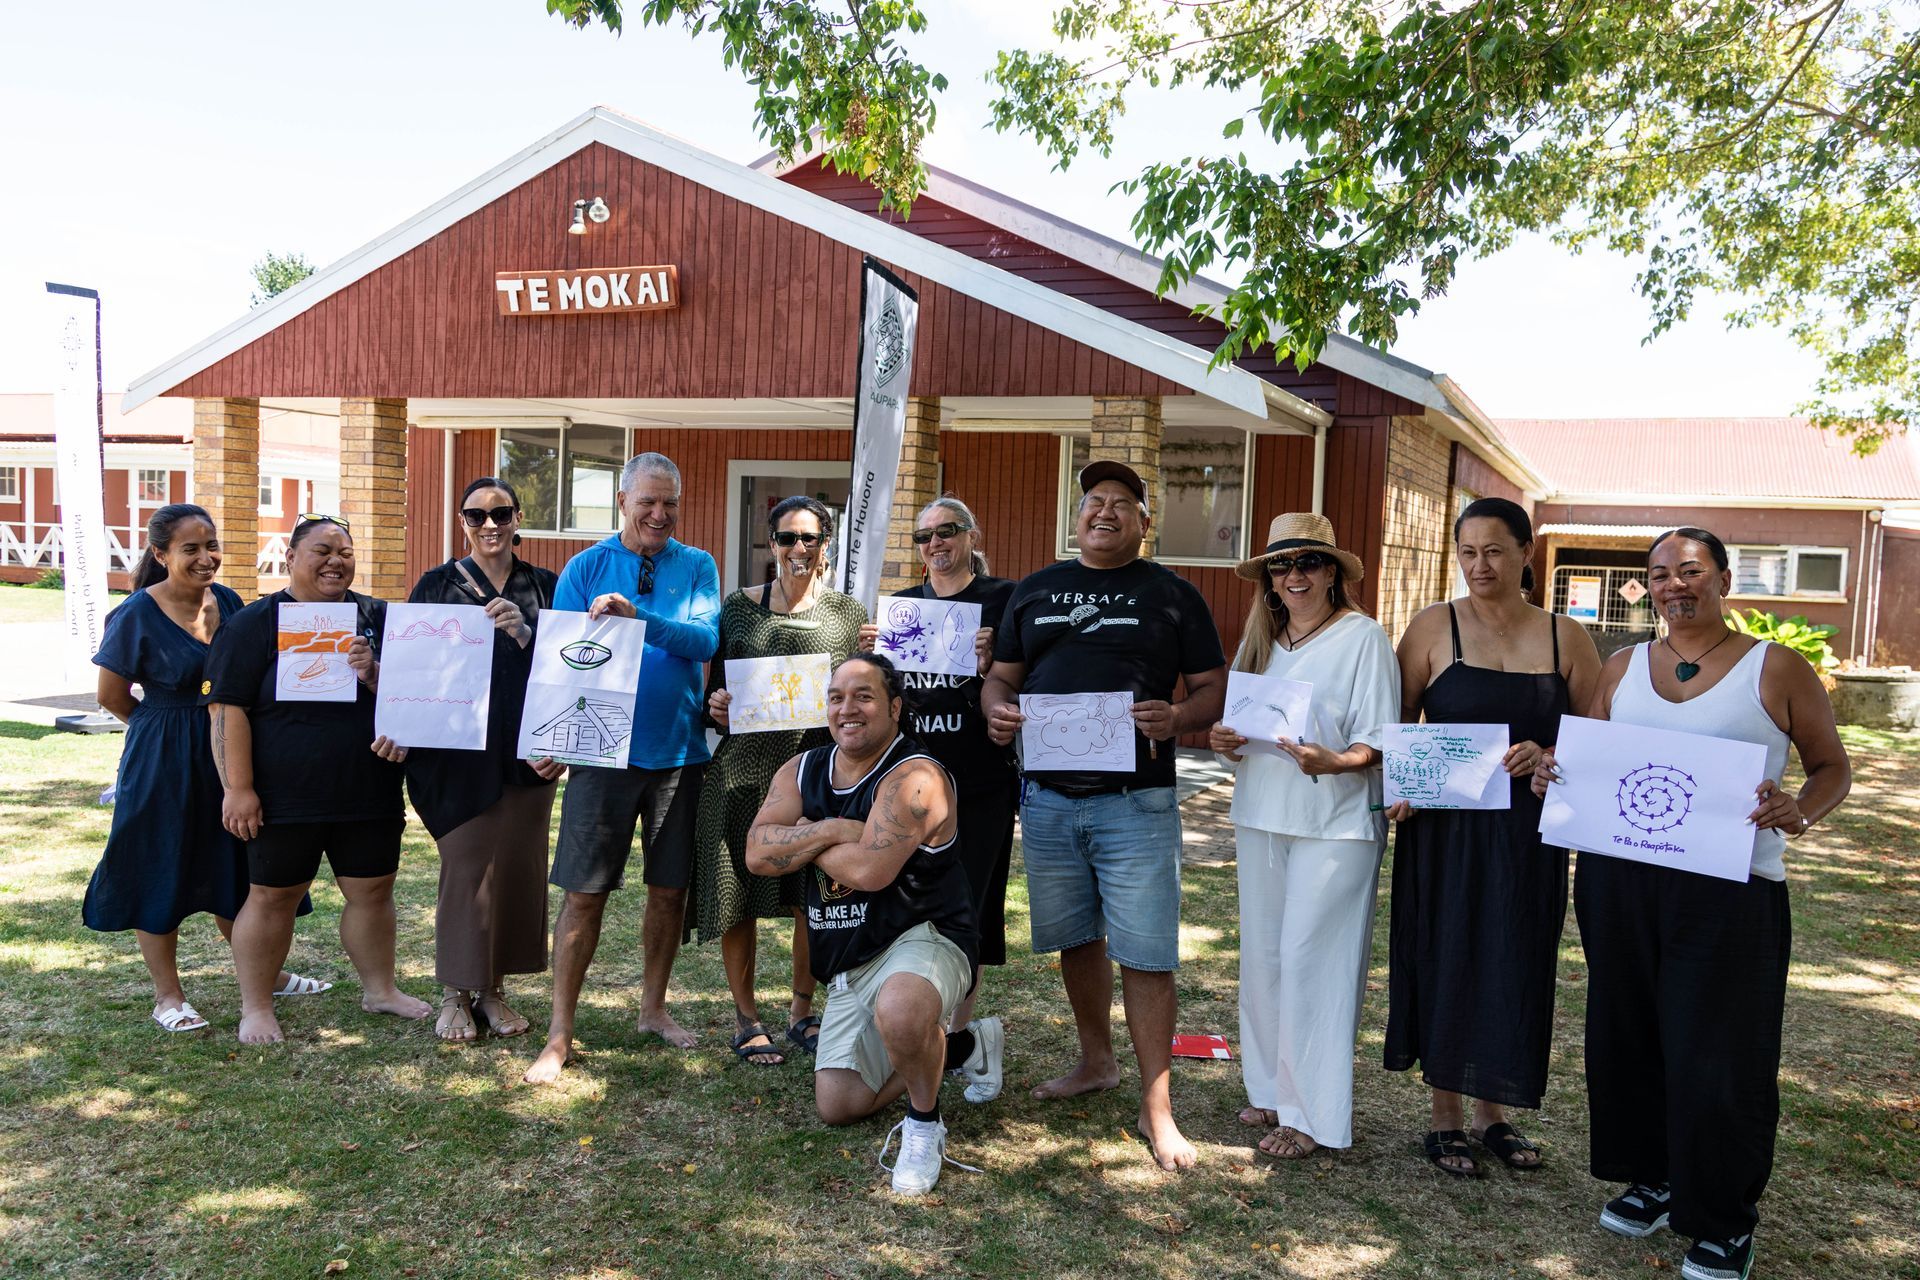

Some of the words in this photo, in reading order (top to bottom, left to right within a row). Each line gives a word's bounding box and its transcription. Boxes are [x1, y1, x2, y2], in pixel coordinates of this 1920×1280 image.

[496, 278, 551, 312] TE
[557, 272, 670, 310] MOKAI
[854, 470, 875, 534] Hauora
[74, 513, 89, 579] Pathways
[851, 539, 861, 554] te
[909, 713, 962, 733] NAU
[1612, 836, 1623, 844] Te
[825, 905, 848, 919] AKE
